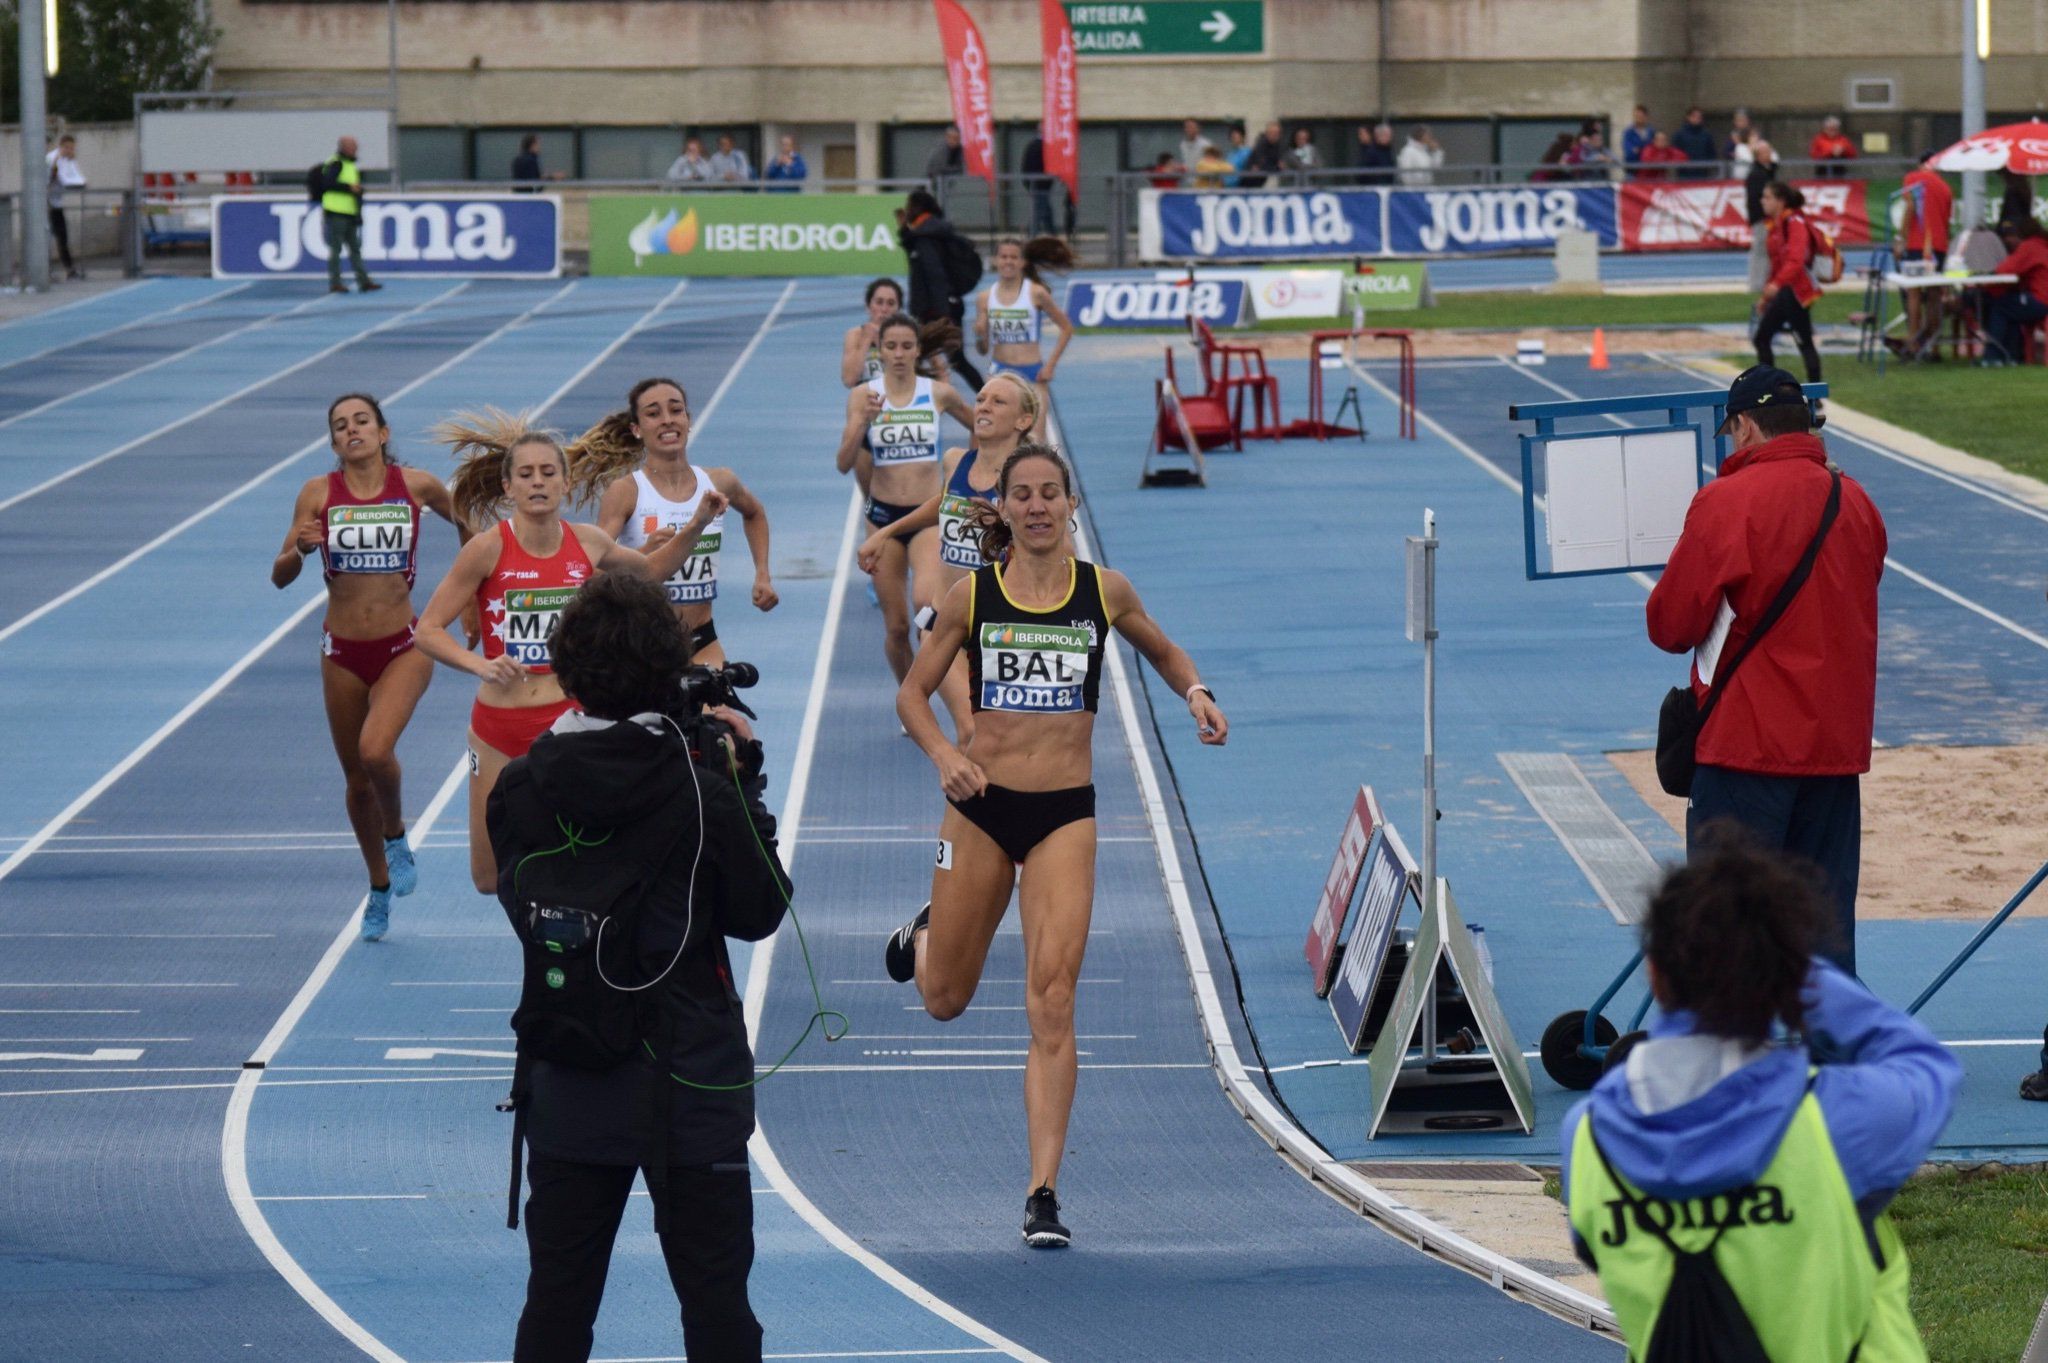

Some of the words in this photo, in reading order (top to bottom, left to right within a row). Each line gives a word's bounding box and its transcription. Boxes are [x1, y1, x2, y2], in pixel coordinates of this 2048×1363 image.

[1070, 5, 1147, 25] IRTEERA
[1072, 31, 1142, 50] SALIDA
[1190, 192, 1354, 255] Joma
[1419, 189, 1586, 251] Joma
[704, 223, 898, 252] IBERDROLA
[1078, 282, 1227, 327] Joma
[993, 320, 1026, 331] ARA
[880, 425, 928, 445] GAL
[881, 446, 930, 460] Joma
[353, 511, 406, 521] IBERDROLA
[336, 526, 403, 550] CLM
[944, 519, 980, 543] CA
[338, 553, 401, 569] Joma
[941, 544, 982, 566] Jom
[665, 556, 713, 581] VA
[534, 595, 577, 606] IBERDR
[668, 583, 714, 601] oma
[509, 612, 561, 640] MA
[1015, 632, 1083, 647] IBERDROLA
[997, 651, 1073, 682] BAL
[991, 685, 1073, 707] Joma
[936, 840, 945, 865] 3
[1601, 1184, 1794, 1247] Joma
